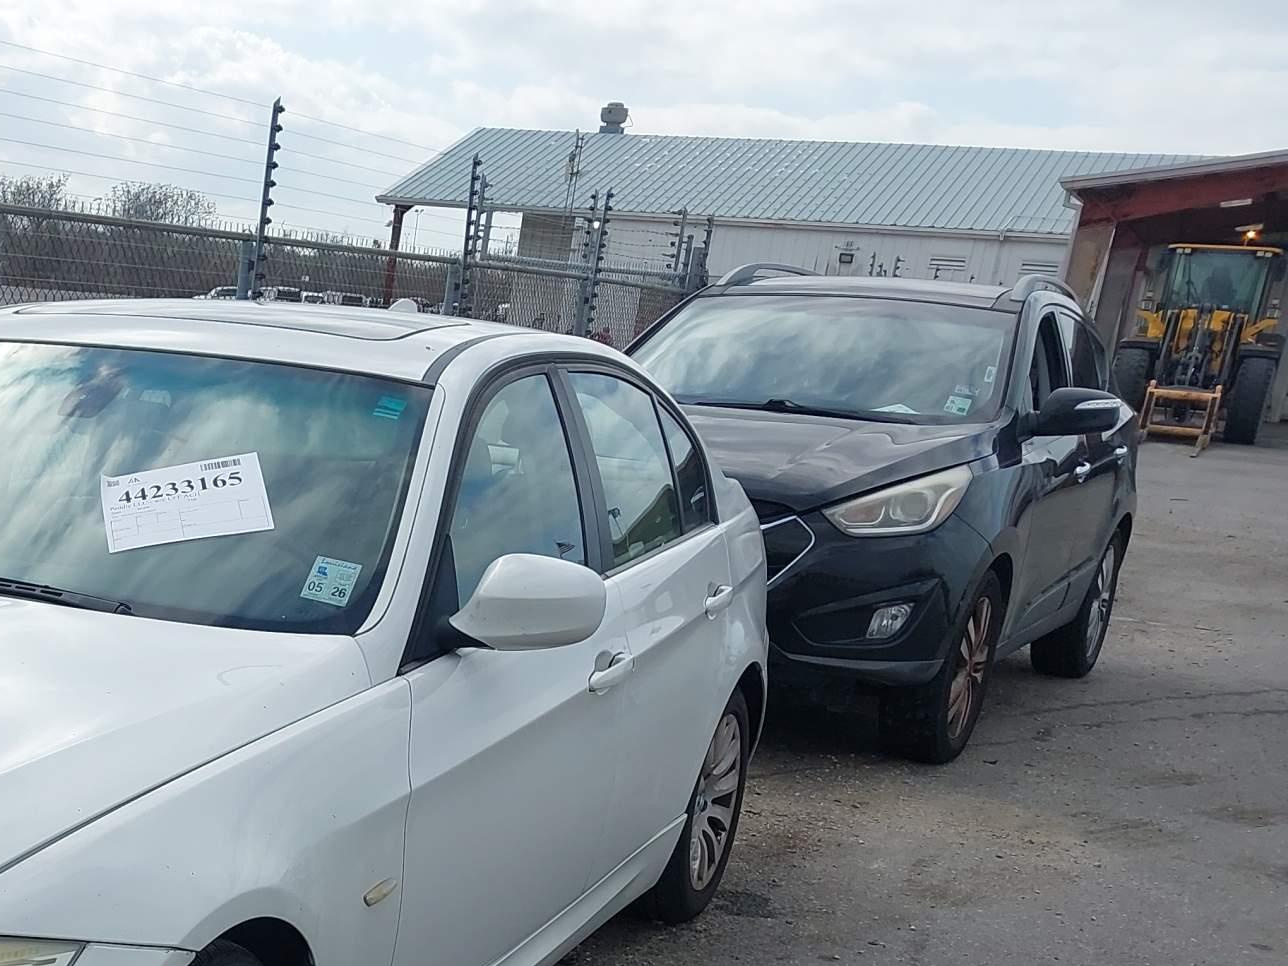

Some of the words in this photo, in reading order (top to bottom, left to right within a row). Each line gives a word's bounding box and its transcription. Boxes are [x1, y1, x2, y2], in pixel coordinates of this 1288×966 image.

[118, 471, 243, 504] 44233165
[307, 580, 323, 593] 05
[331, 586, 347, 599] 26
